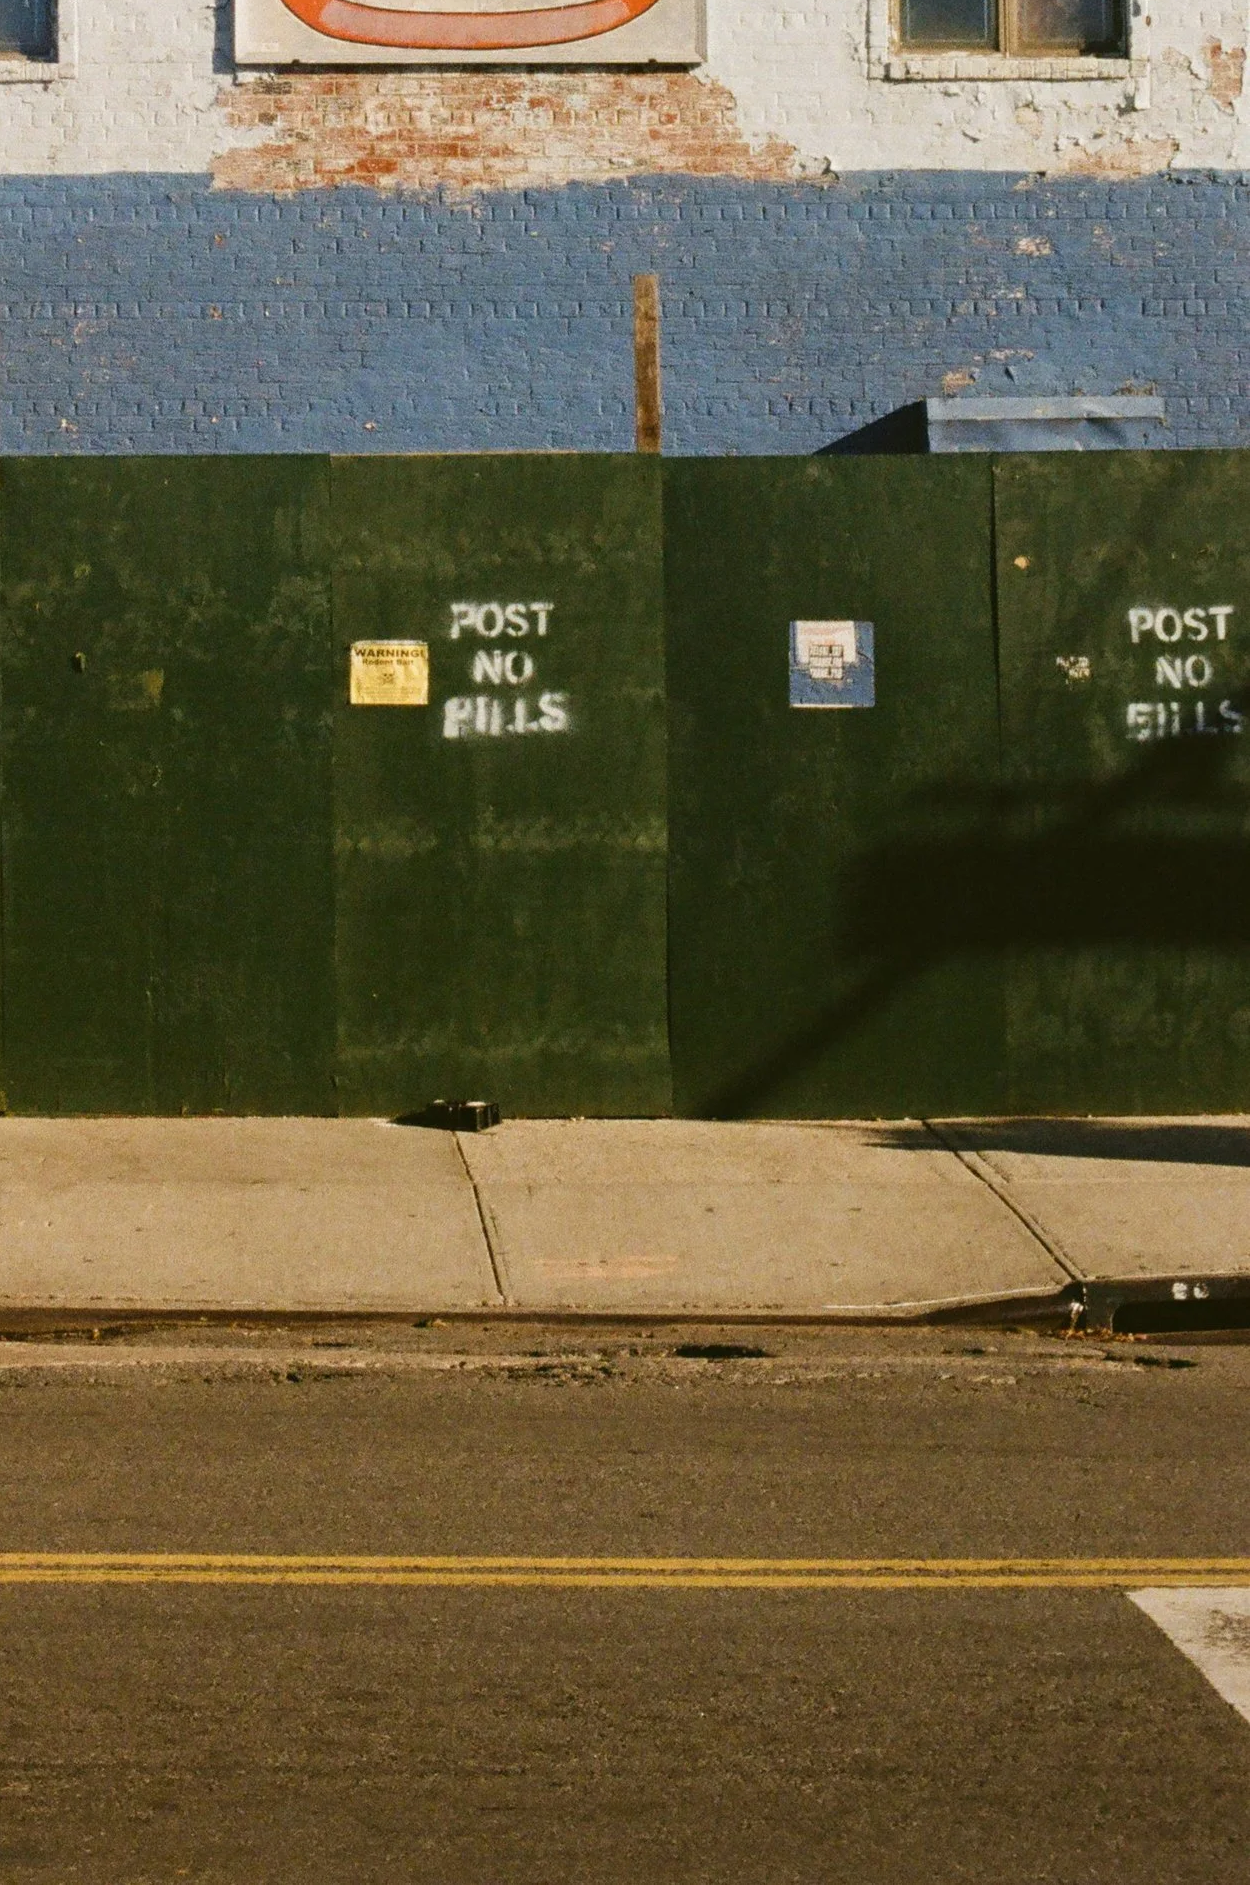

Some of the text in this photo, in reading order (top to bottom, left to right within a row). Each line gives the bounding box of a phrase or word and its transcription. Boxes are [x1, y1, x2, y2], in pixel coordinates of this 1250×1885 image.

[450, 601, 555, 640] POST
[1127, 604, 1235, 644] POST
[473, 649, 534, 684] NO
[1155, 654, 1214, 689] NO
